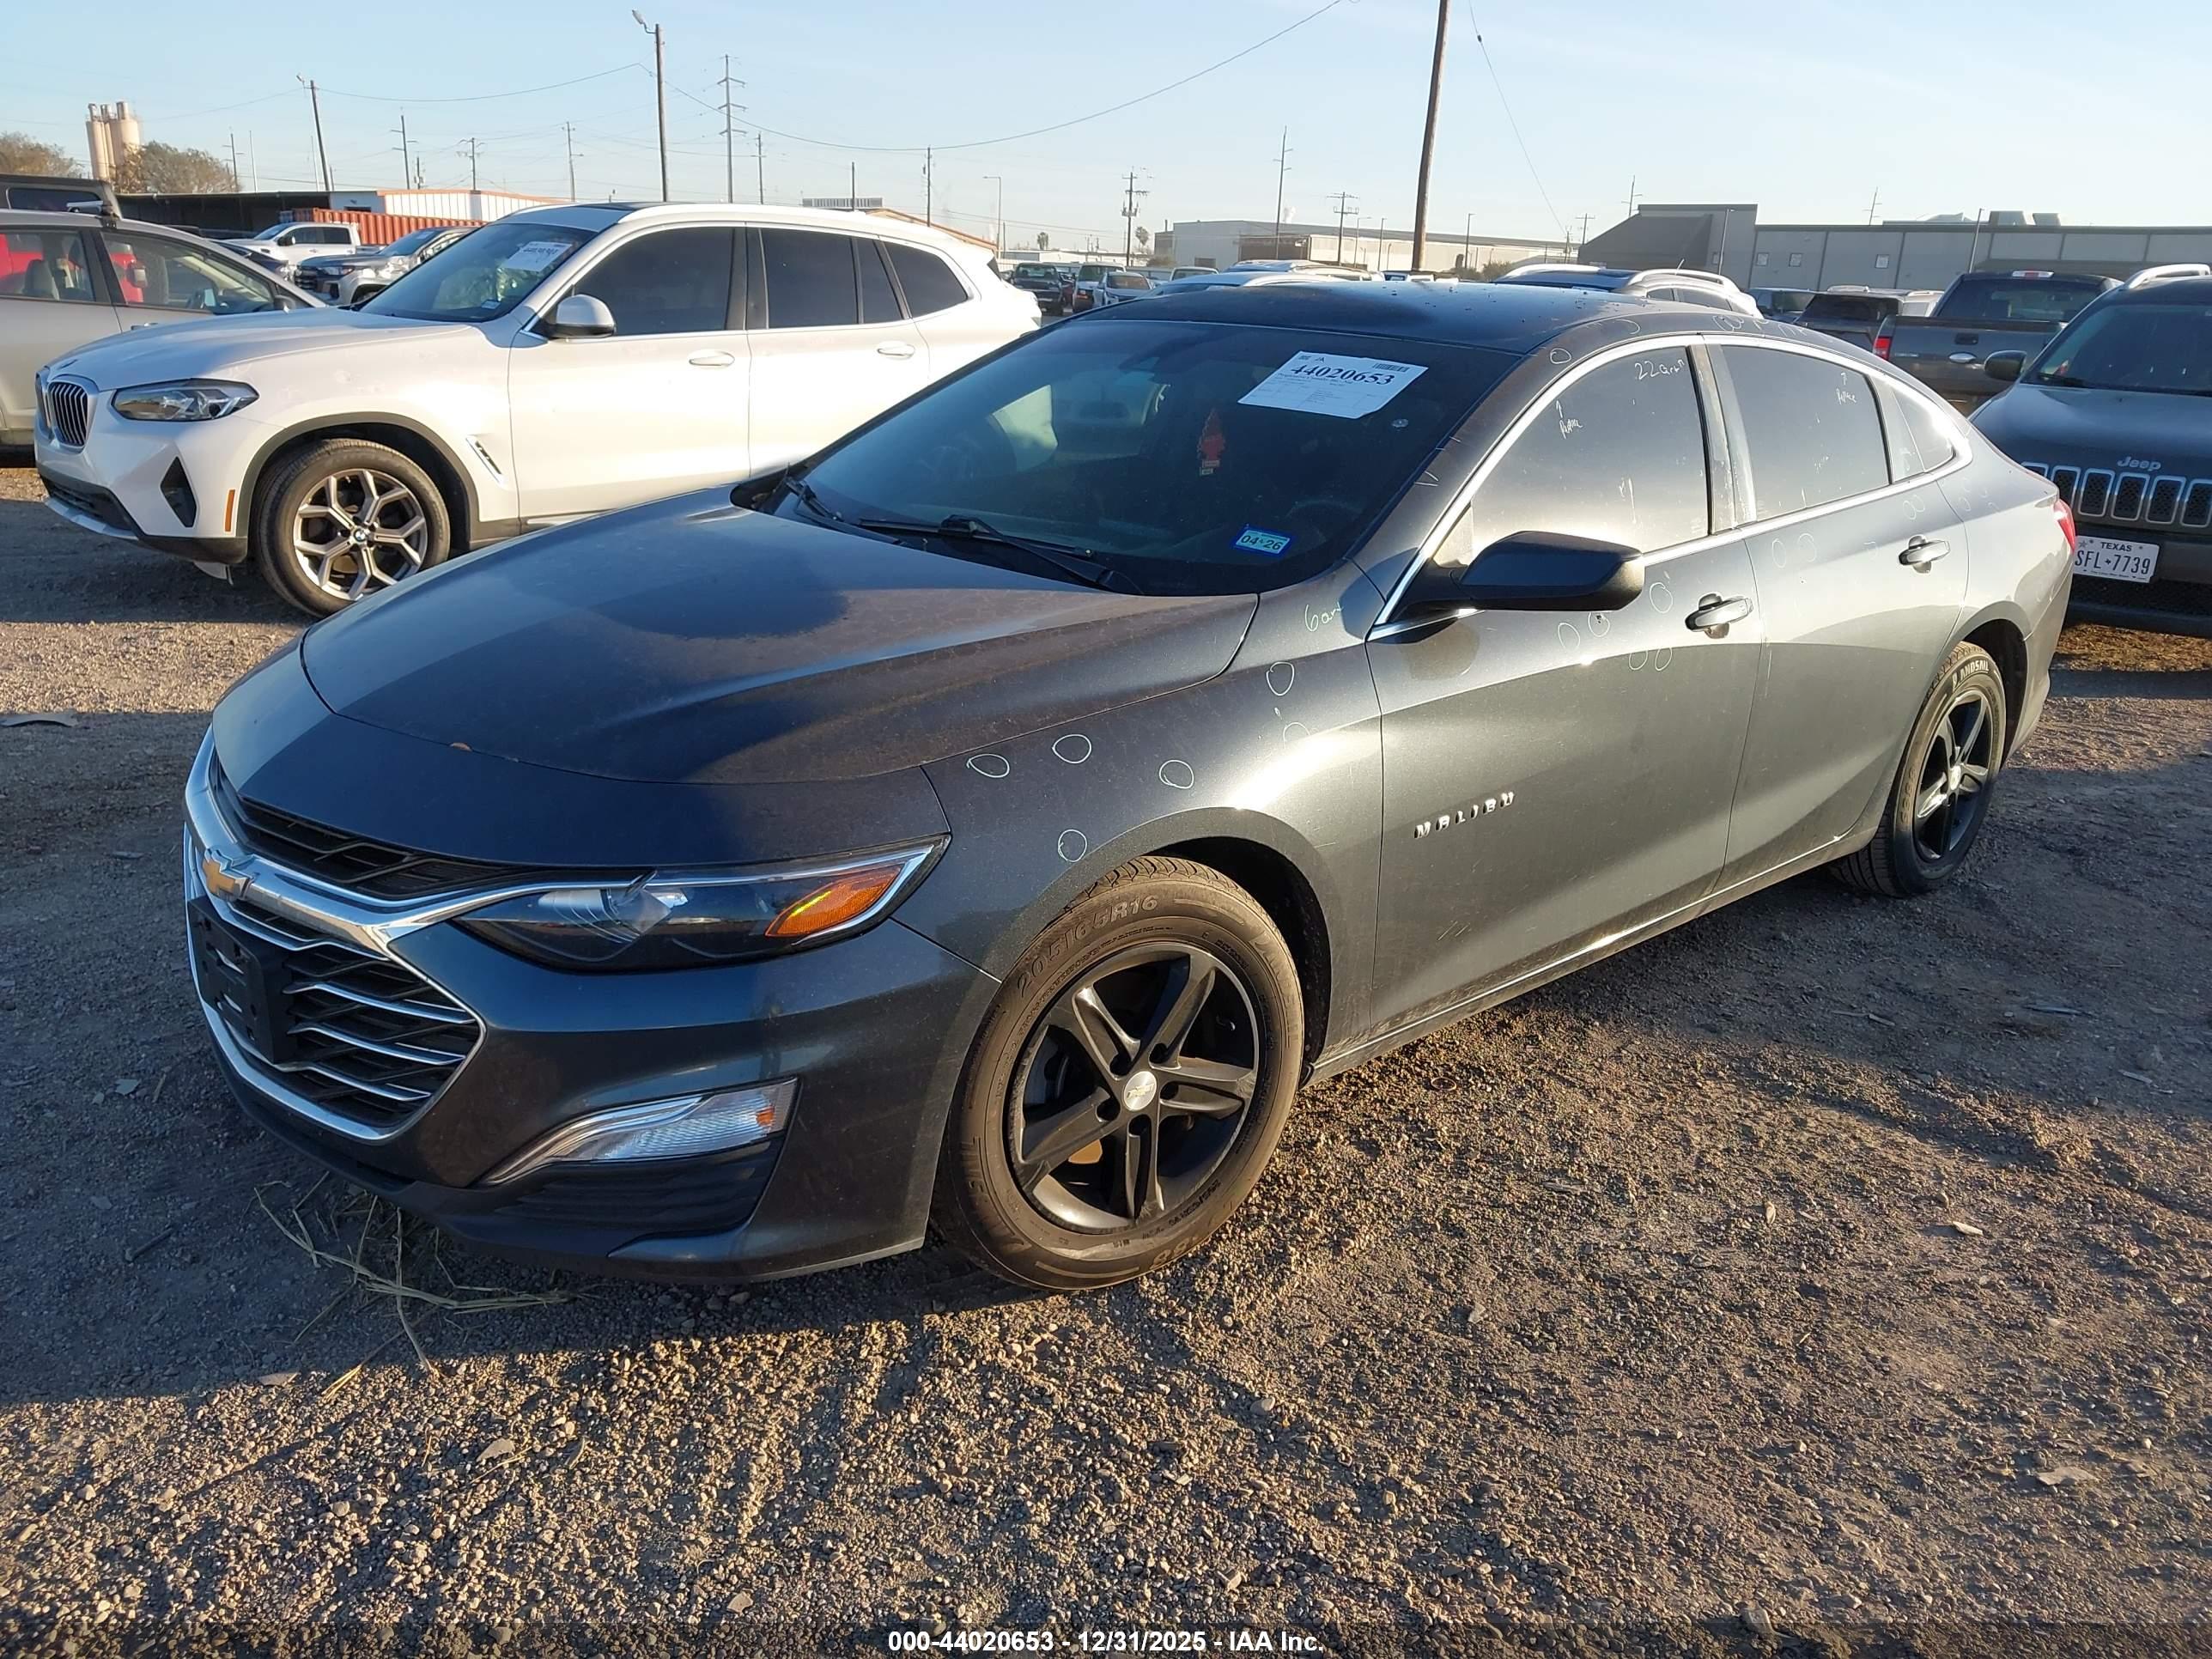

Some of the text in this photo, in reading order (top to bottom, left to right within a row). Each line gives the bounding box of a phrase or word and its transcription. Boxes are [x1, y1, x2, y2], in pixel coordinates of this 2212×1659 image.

[1291, 364, 1395, 386] 44020653
[2117, 456, 2161, 471] Jeep
[2100, 542, 2132, 552] TEXAS
[1414, 791, 1515, 839] MALIBU
